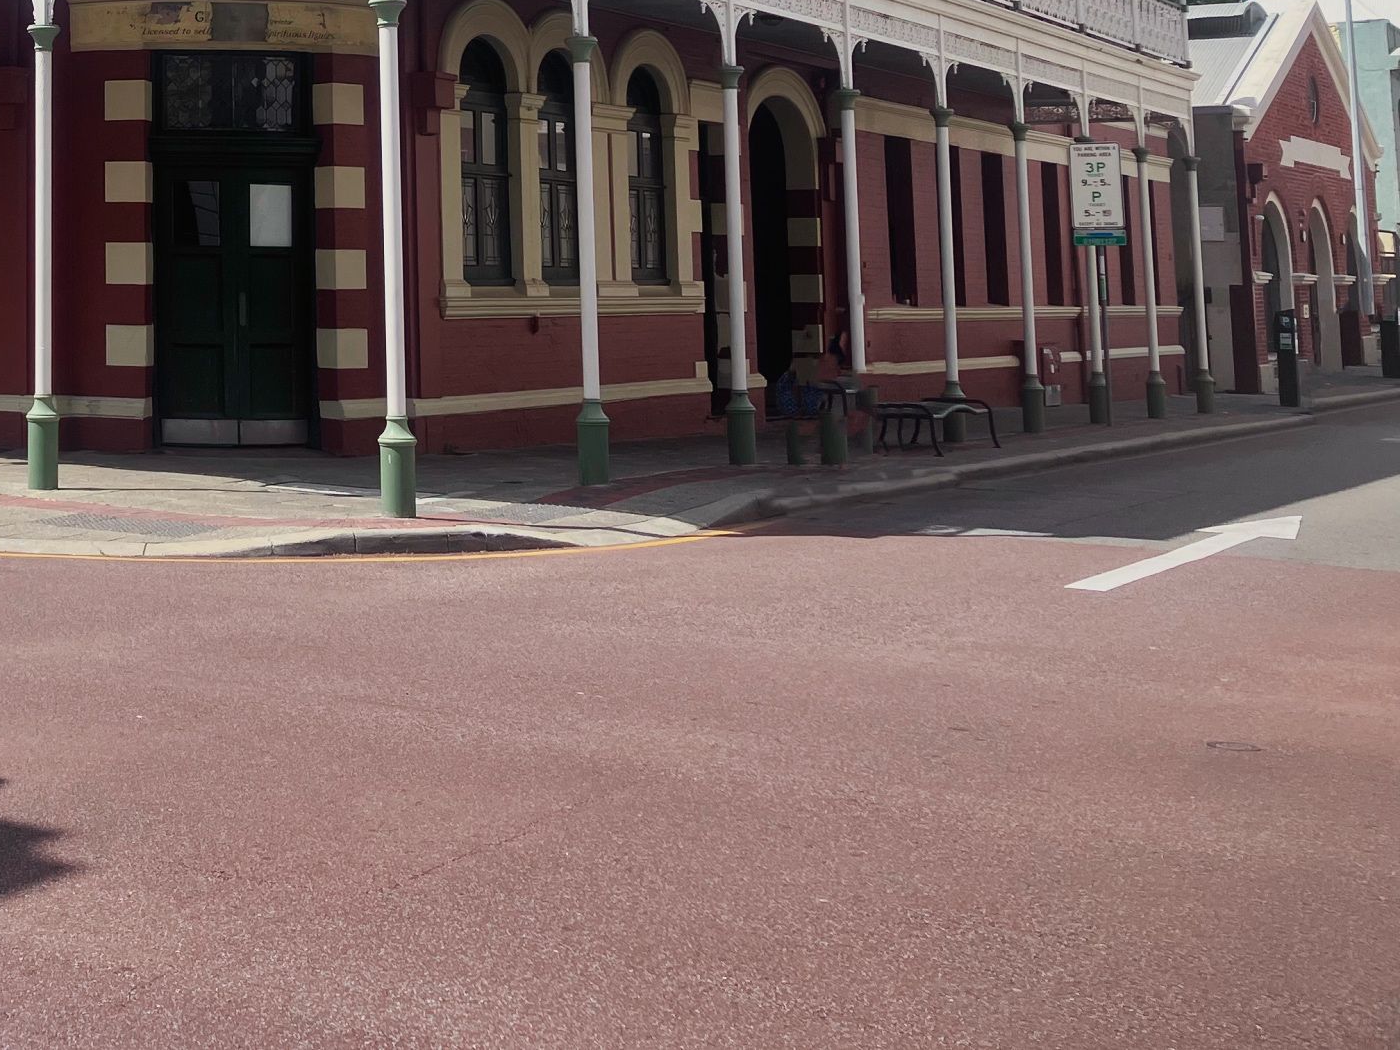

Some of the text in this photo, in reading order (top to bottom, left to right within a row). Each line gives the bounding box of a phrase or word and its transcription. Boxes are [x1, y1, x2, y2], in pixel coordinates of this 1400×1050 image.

[266, 29, 306, 40] pirituous
[1085, 162, 1106, 173] 3P
[1092, 191, 1102, 202] P
